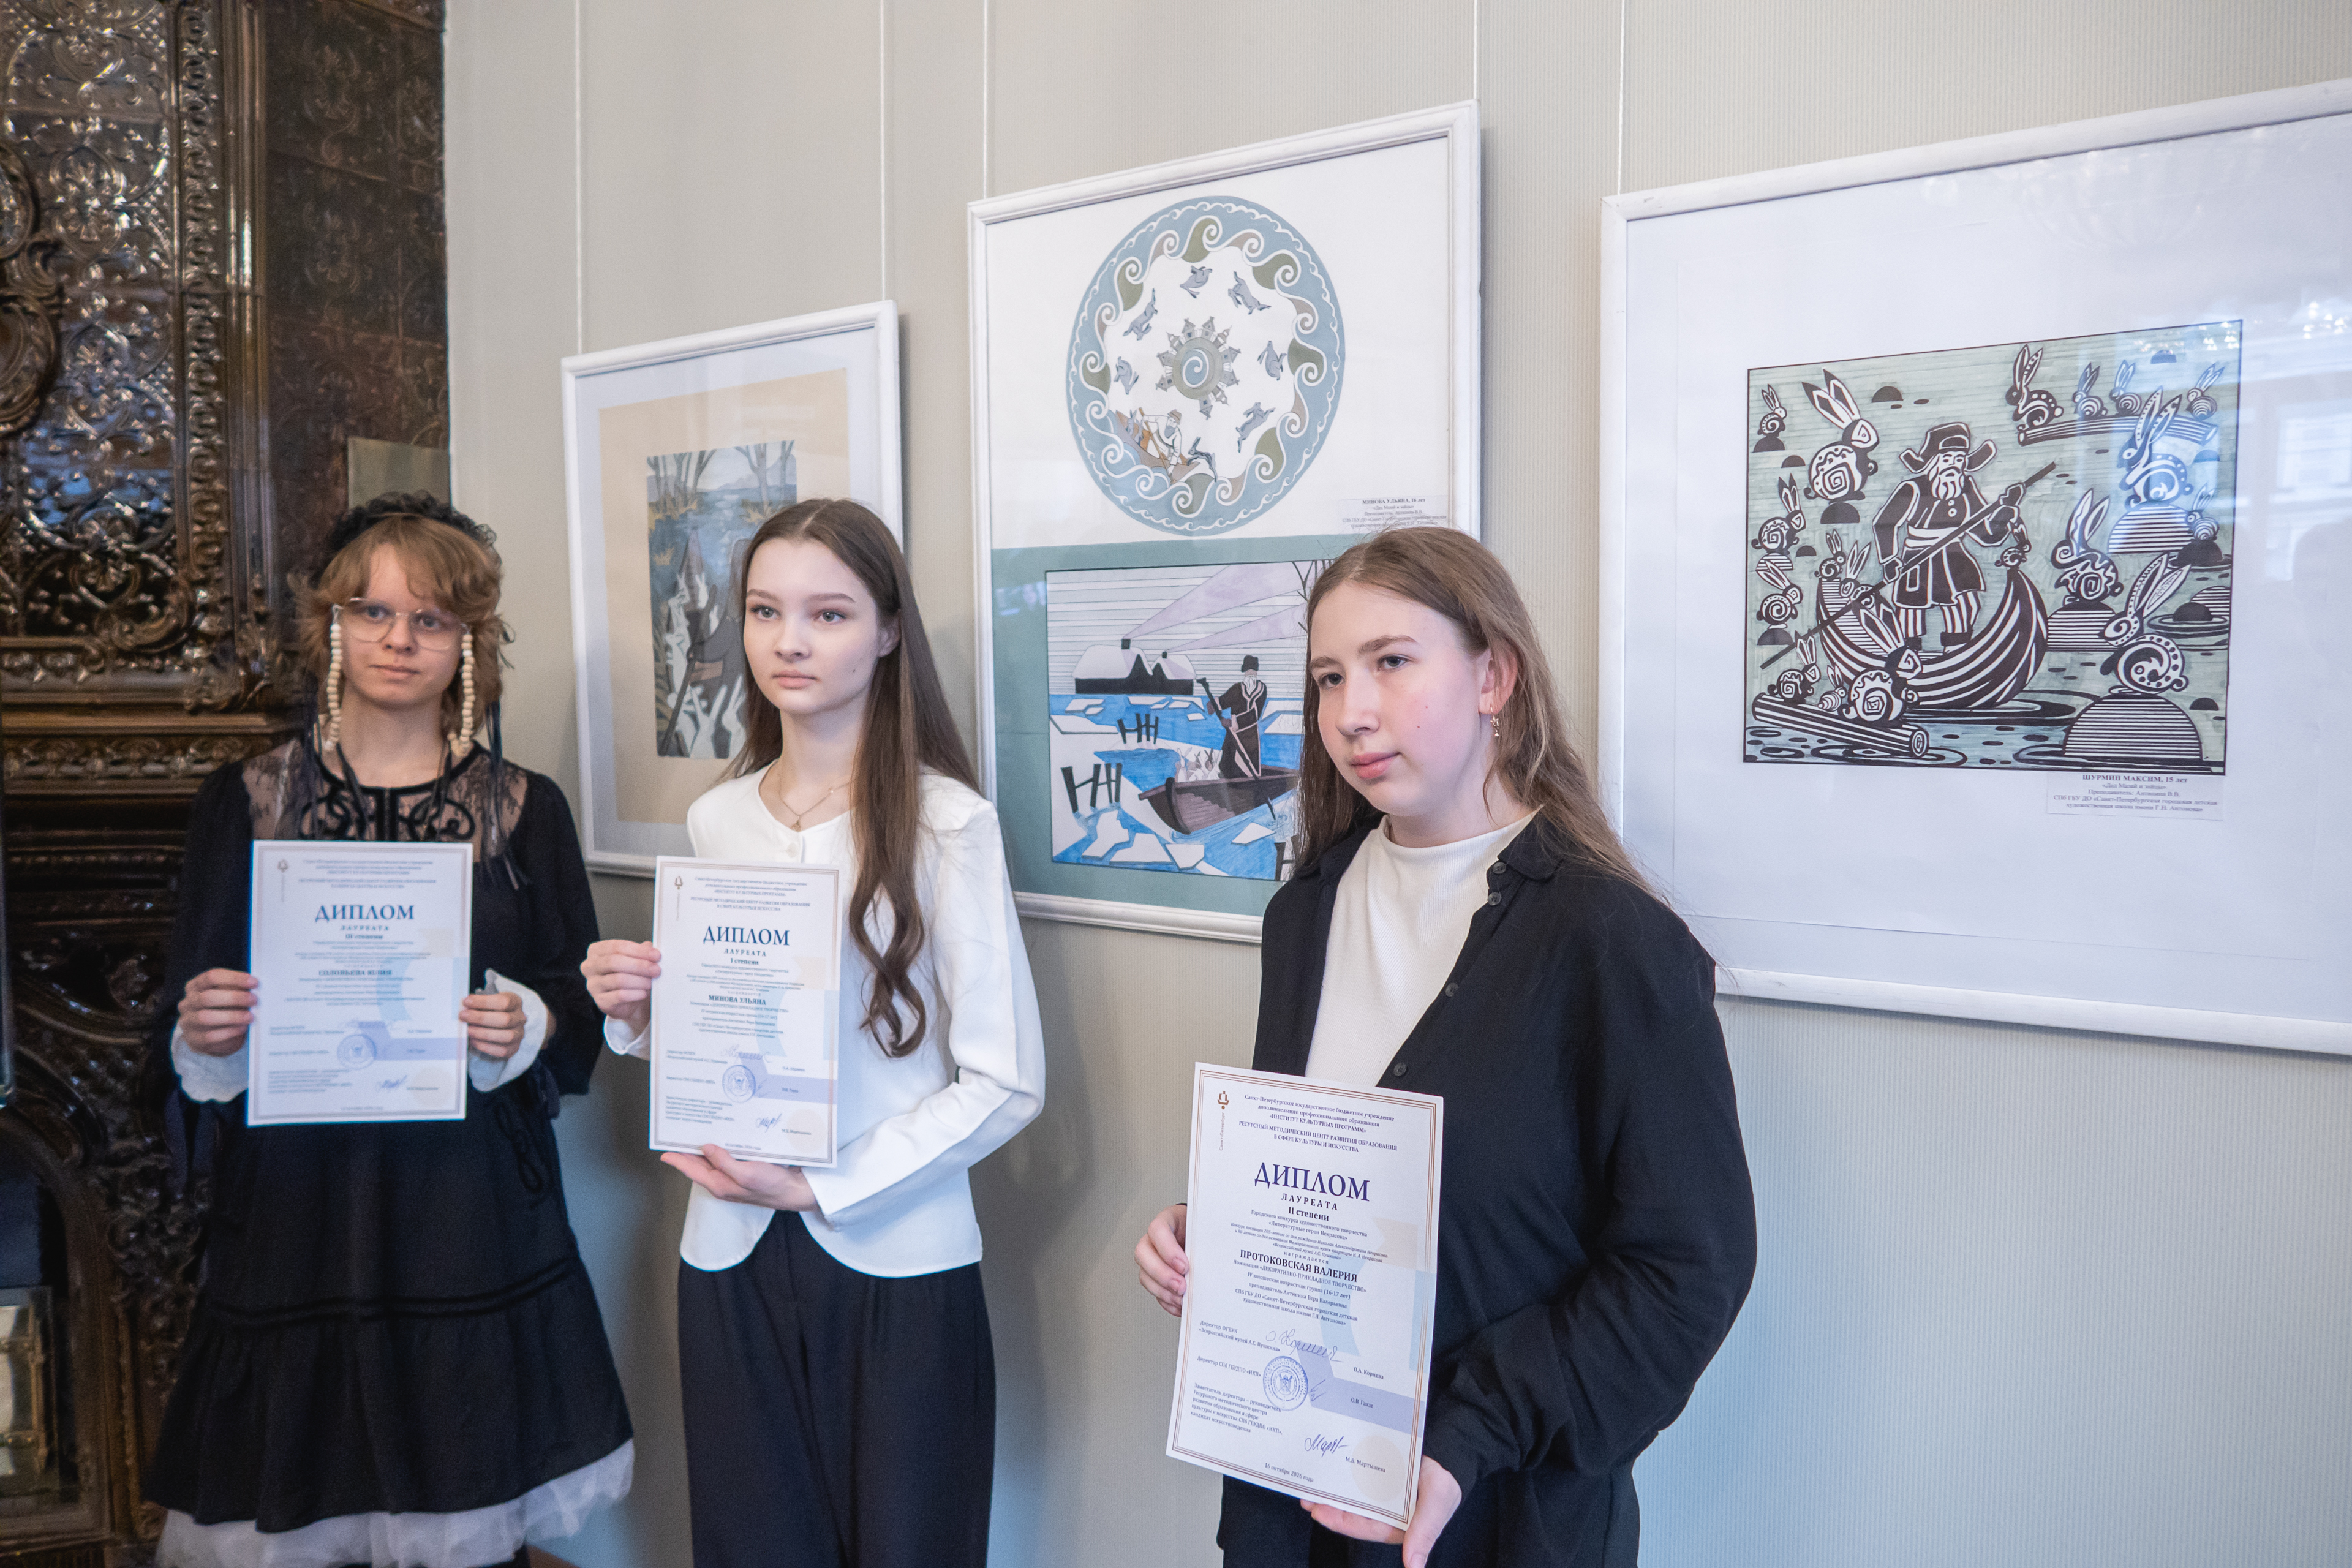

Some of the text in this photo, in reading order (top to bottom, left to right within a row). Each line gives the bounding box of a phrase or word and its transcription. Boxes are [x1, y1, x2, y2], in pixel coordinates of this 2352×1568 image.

[315, 905, 414, 922] ДИПЛОМ
[703, 925, 790, 946] ДИПЛОМ
[724, 948, 766, 957] ЛАУРЕАТА
[709, 995, 766, 1006] МИНОВА УЛЬЯНА
[1245, 1094, 1395, 1121] Санкт-Петербургское государственное бюджетное учреждение
[1257, 1105, 1380, 1128] дополнительного профессионального образования
[1299, 1118, 1333, 1128] КУЛЬТУРНЫХ
[1238, 1120, 1268, 1130] РЕСУРСНЫЙ
[1269, 1125, 1312, 1137] МЕТОДИЧЕСКИЙ
[1330, 1135, 1357, 1145] РАЗВИТИЯ
[1357, 1139, 1398, 1151] ОБРАЗОВАНИЯ
[1295, 1137, 1322, 1147] КУЛЬТУРЫ
[1327, 1142, 1359, 1153] ИСКУССТВА
[1254, 1162, 1370, 1202] ДИПЛОМ
[1281, 1193, 1338, 1211] ЛАУРЕАТА
[1288, 1206, 1329, 1221] II степени
[1251, 1209, 1368, 1237] Городского конкурса художественного творчества
[1233, 1259, 1259, 1269] Номинация
[1240, 1250, 1357, 1283] ПРОТОКОВСКАЯ ВАЛЕРИЯ
[1284, 1251, 1329, 1265] награждается
[1253, 1274, 1280, 1283] юношеская
[1280, 1280, 1306, 1289] возрастная
[1243, 1297, 1280, 1310] художественная
[1248, 1283, 1348, 1309] преподаватель Антипина Вера Валерьевна
[1314, 1307, 1338, 1317] городская
[1338, 1313, 1358, 1322] детская
[1200, 1319, 1238, 1334] Директор ФГБУК
[1196, 1355, 1218, 1366] Директор
[1228, 1363, 1246, 1373] ГБУДПО
[1363, 1369, 1384, 1380] Корнева
[1192, 1397, 1213, 1407] развития
[1213, 1403, 1242, 1415] образования
[1193, 1389, 1268, 1416] Ресурсного методического центра
[1194, 1383, 1282, 1413] Заместитель директора руководитель
[1360, 1399, 1374, 1409] Гаазе
[1190, 1411, 1251, 1433] кандидат искусствоведения
[1191, 1404, 1212, 1414] культуры
[1216, 1411, 1238, 1422] искусства
[1248, 1419, 1266, 1430] ГБУДПО
[1270, 1465, 1291, 1476] октября
[1291, 1471, 1303, 1479] 2026
[1356, 1459, 1386, 1473] Мартышева
